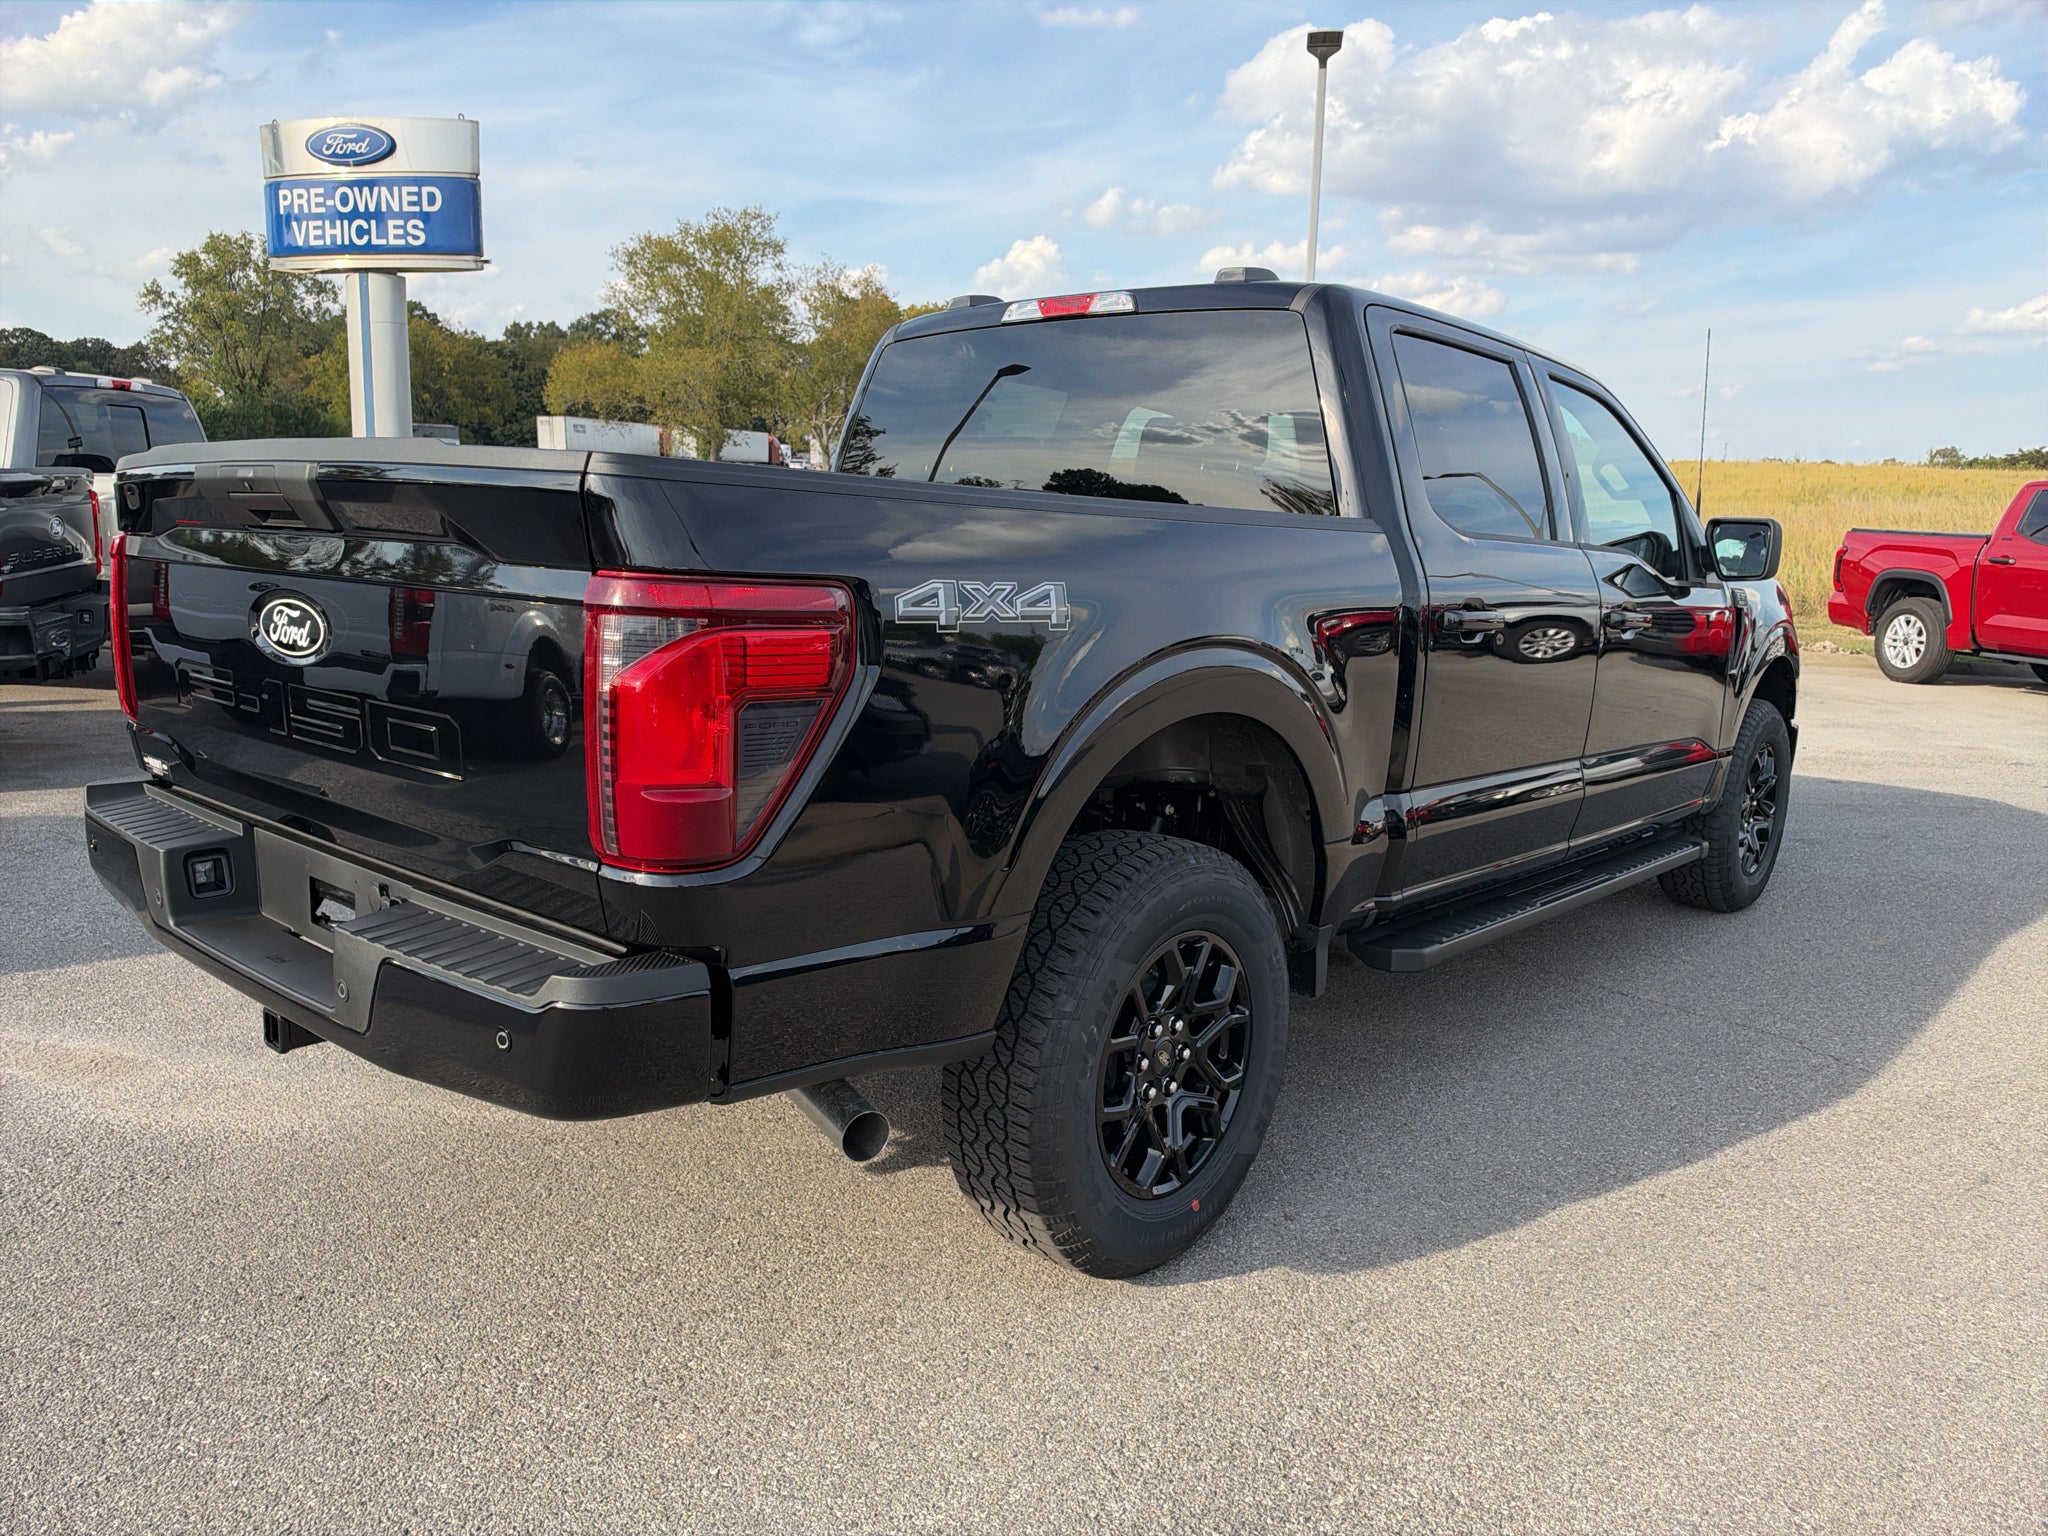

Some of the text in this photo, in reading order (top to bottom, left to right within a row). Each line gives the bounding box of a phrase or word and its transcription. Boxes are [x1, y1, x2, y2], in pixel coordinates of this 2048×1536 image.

[322, 132, 370, 156] Ford
[278, 186, 442, 215] PRE-OWNED
[291, 218, 426, 247] VEHICLES
[269, 604, 312, 649] Ford
[175, 657, 464, 782] F-150
[743, 720, 799, 730] FORD
